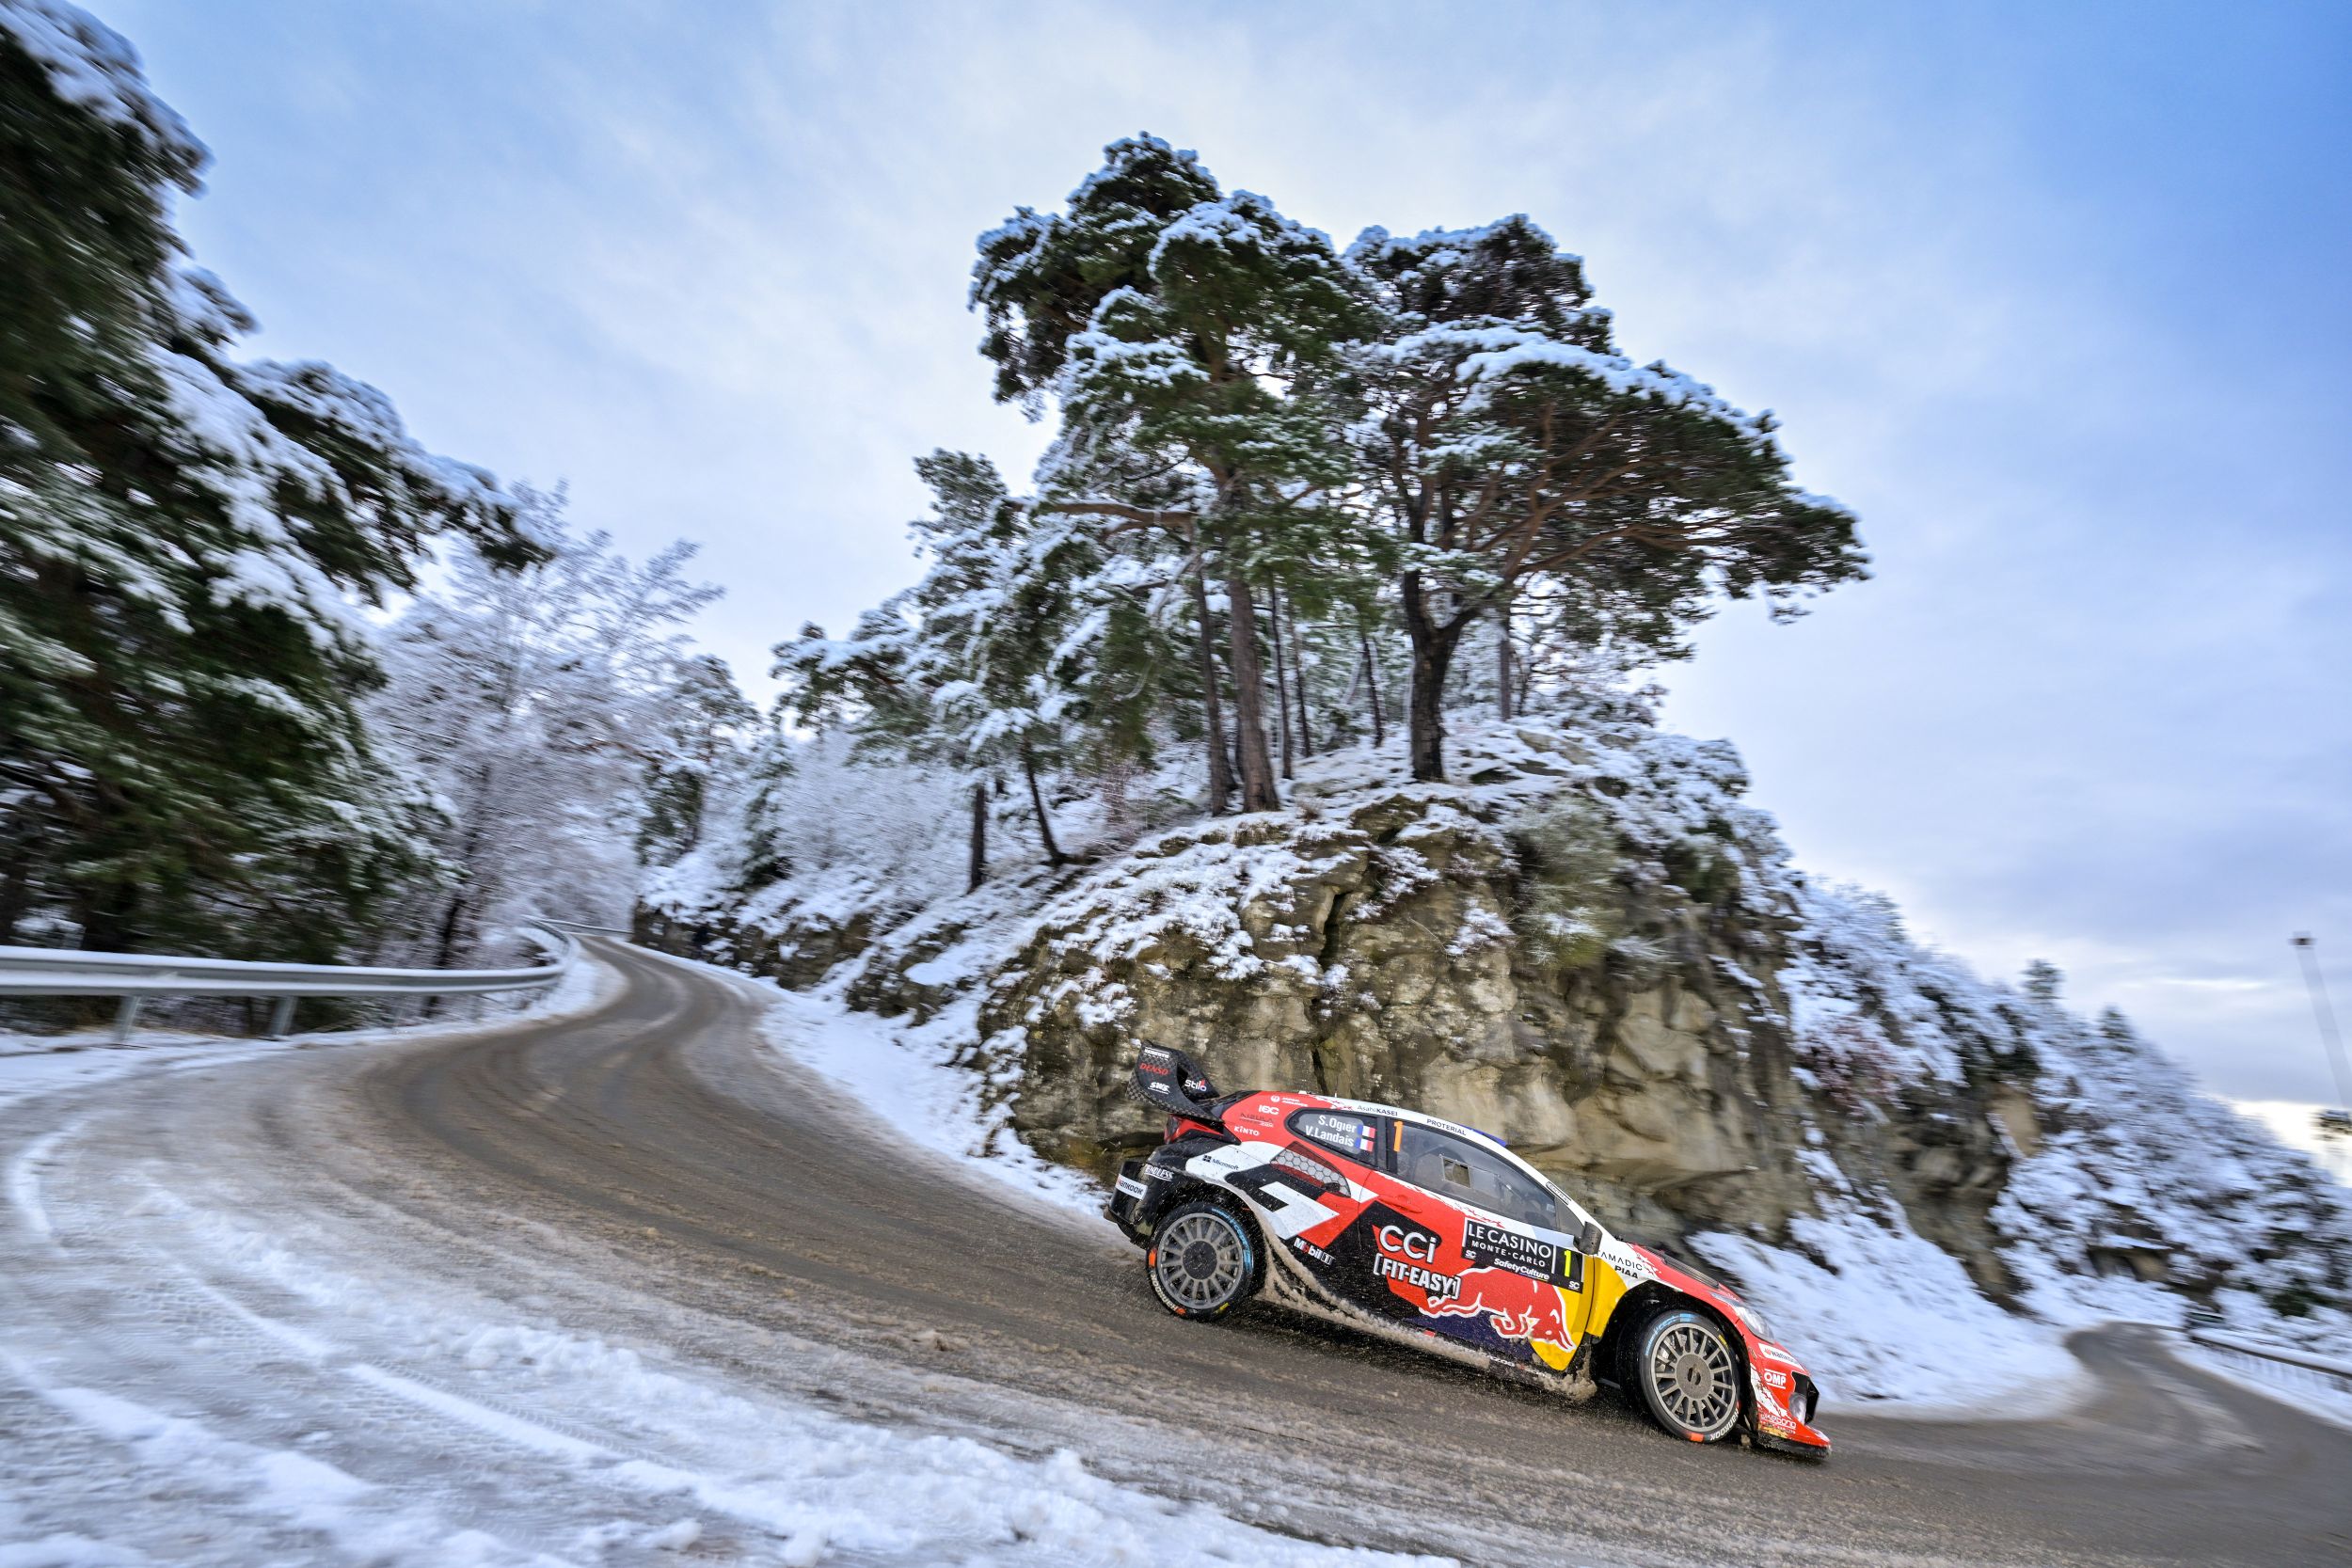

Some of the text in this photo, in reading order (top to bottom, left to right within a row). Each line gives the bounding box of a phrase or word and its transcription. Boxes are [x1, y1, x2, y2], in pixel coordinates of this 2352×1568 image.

[1139, 1062, 1169, 1075] DENSO
[1185, 1079, 1207, 1091] Stilo
[1319, 1116, 1357, 1133] S.Ogier
[1426, 1118, 1467, 1136] PROTERIAL
[1305, 1125, 1355, 1147] V.Landais
[1393, 1120, 1404, 1152] 1
[1145, 1164, 1174, 1180] ENDLESS
[1212, 1158, 1239, 1170] Microsoft
[1468, 1223, 1551, 1259] LE CASINO
[1471, 1240, 1546, 1267] MONTE-CARLO
[1494, 1258, 1550, 1280] SafetyCulture
[1564, 1249, 1572, 1277] 1
[1614, 1265, 1638, 1279] PIAA
[1763, 1371, 1787, 1386] OMP
